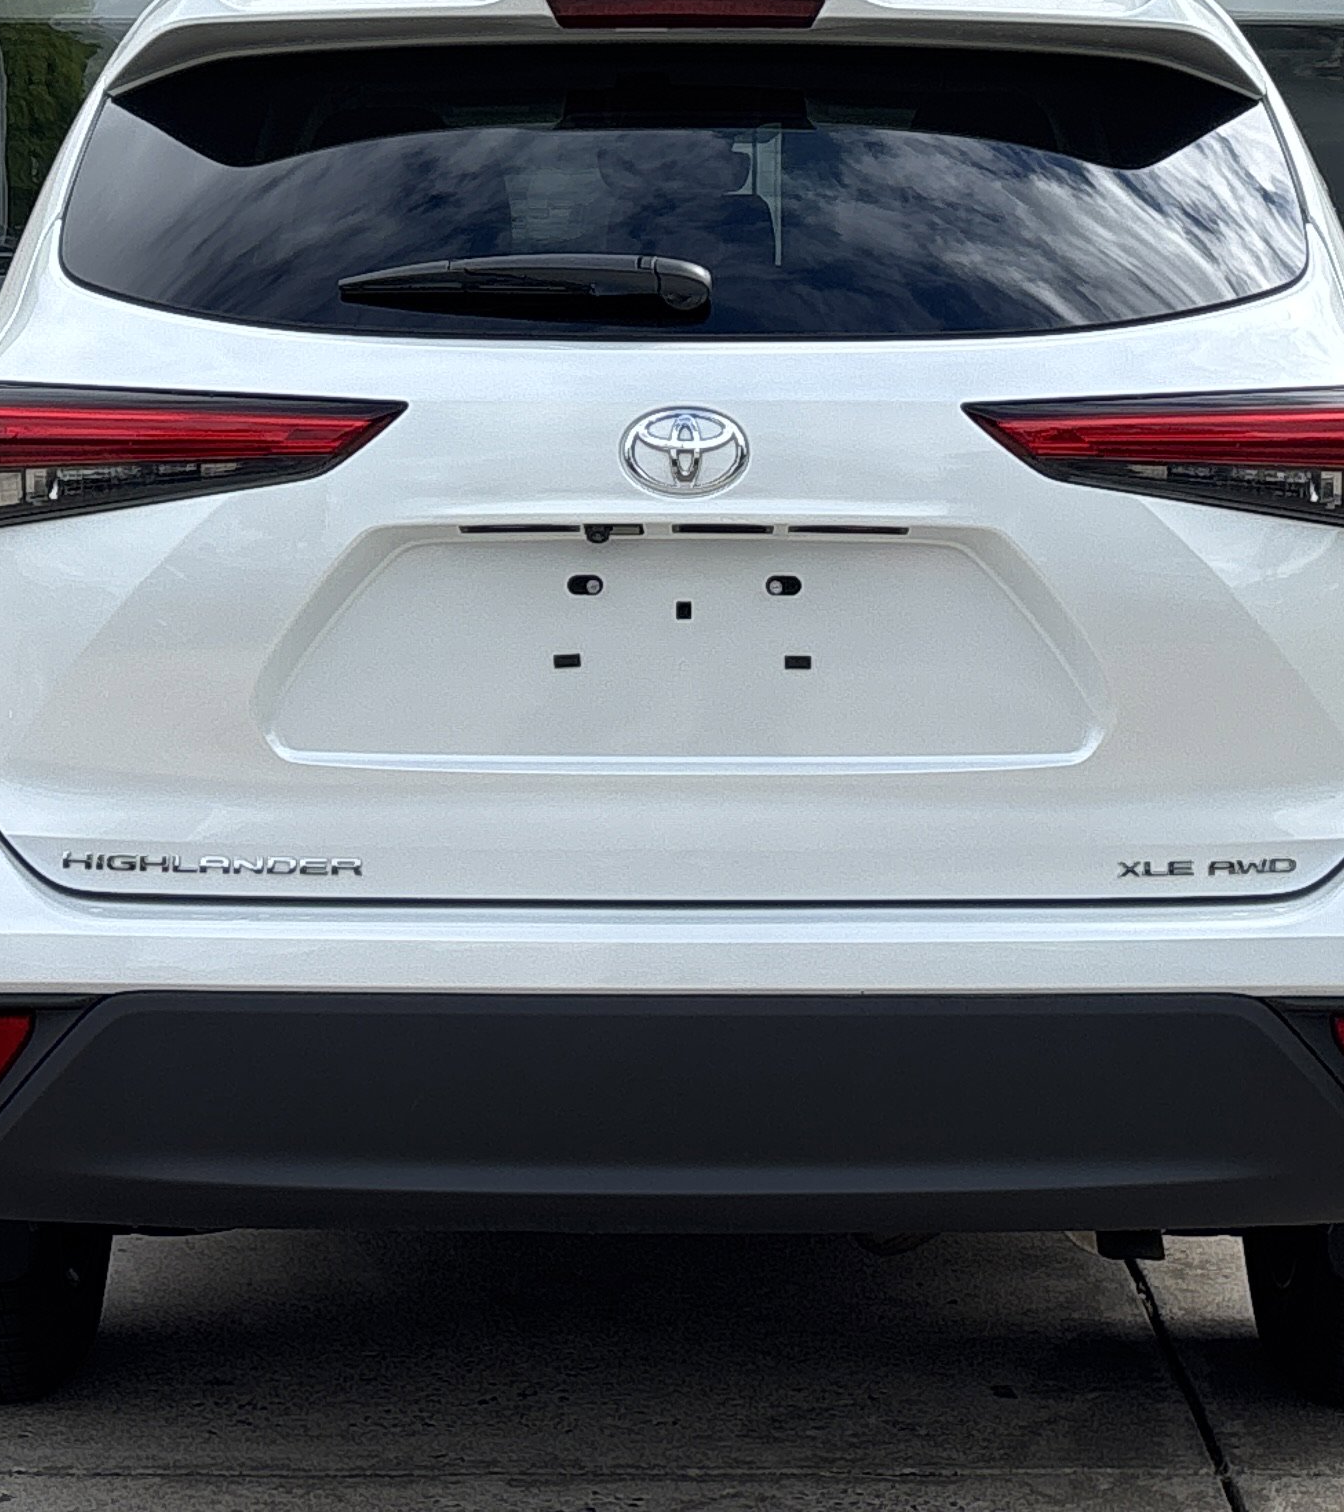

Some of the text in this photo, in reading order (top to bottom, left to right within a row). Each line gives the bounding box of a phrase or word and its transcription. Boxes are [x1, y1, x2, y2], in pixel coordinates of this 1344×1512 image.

[61, 850, 363, 877] HIGHLANDER
[1117, 857, 1297, 878] XLE AWD
